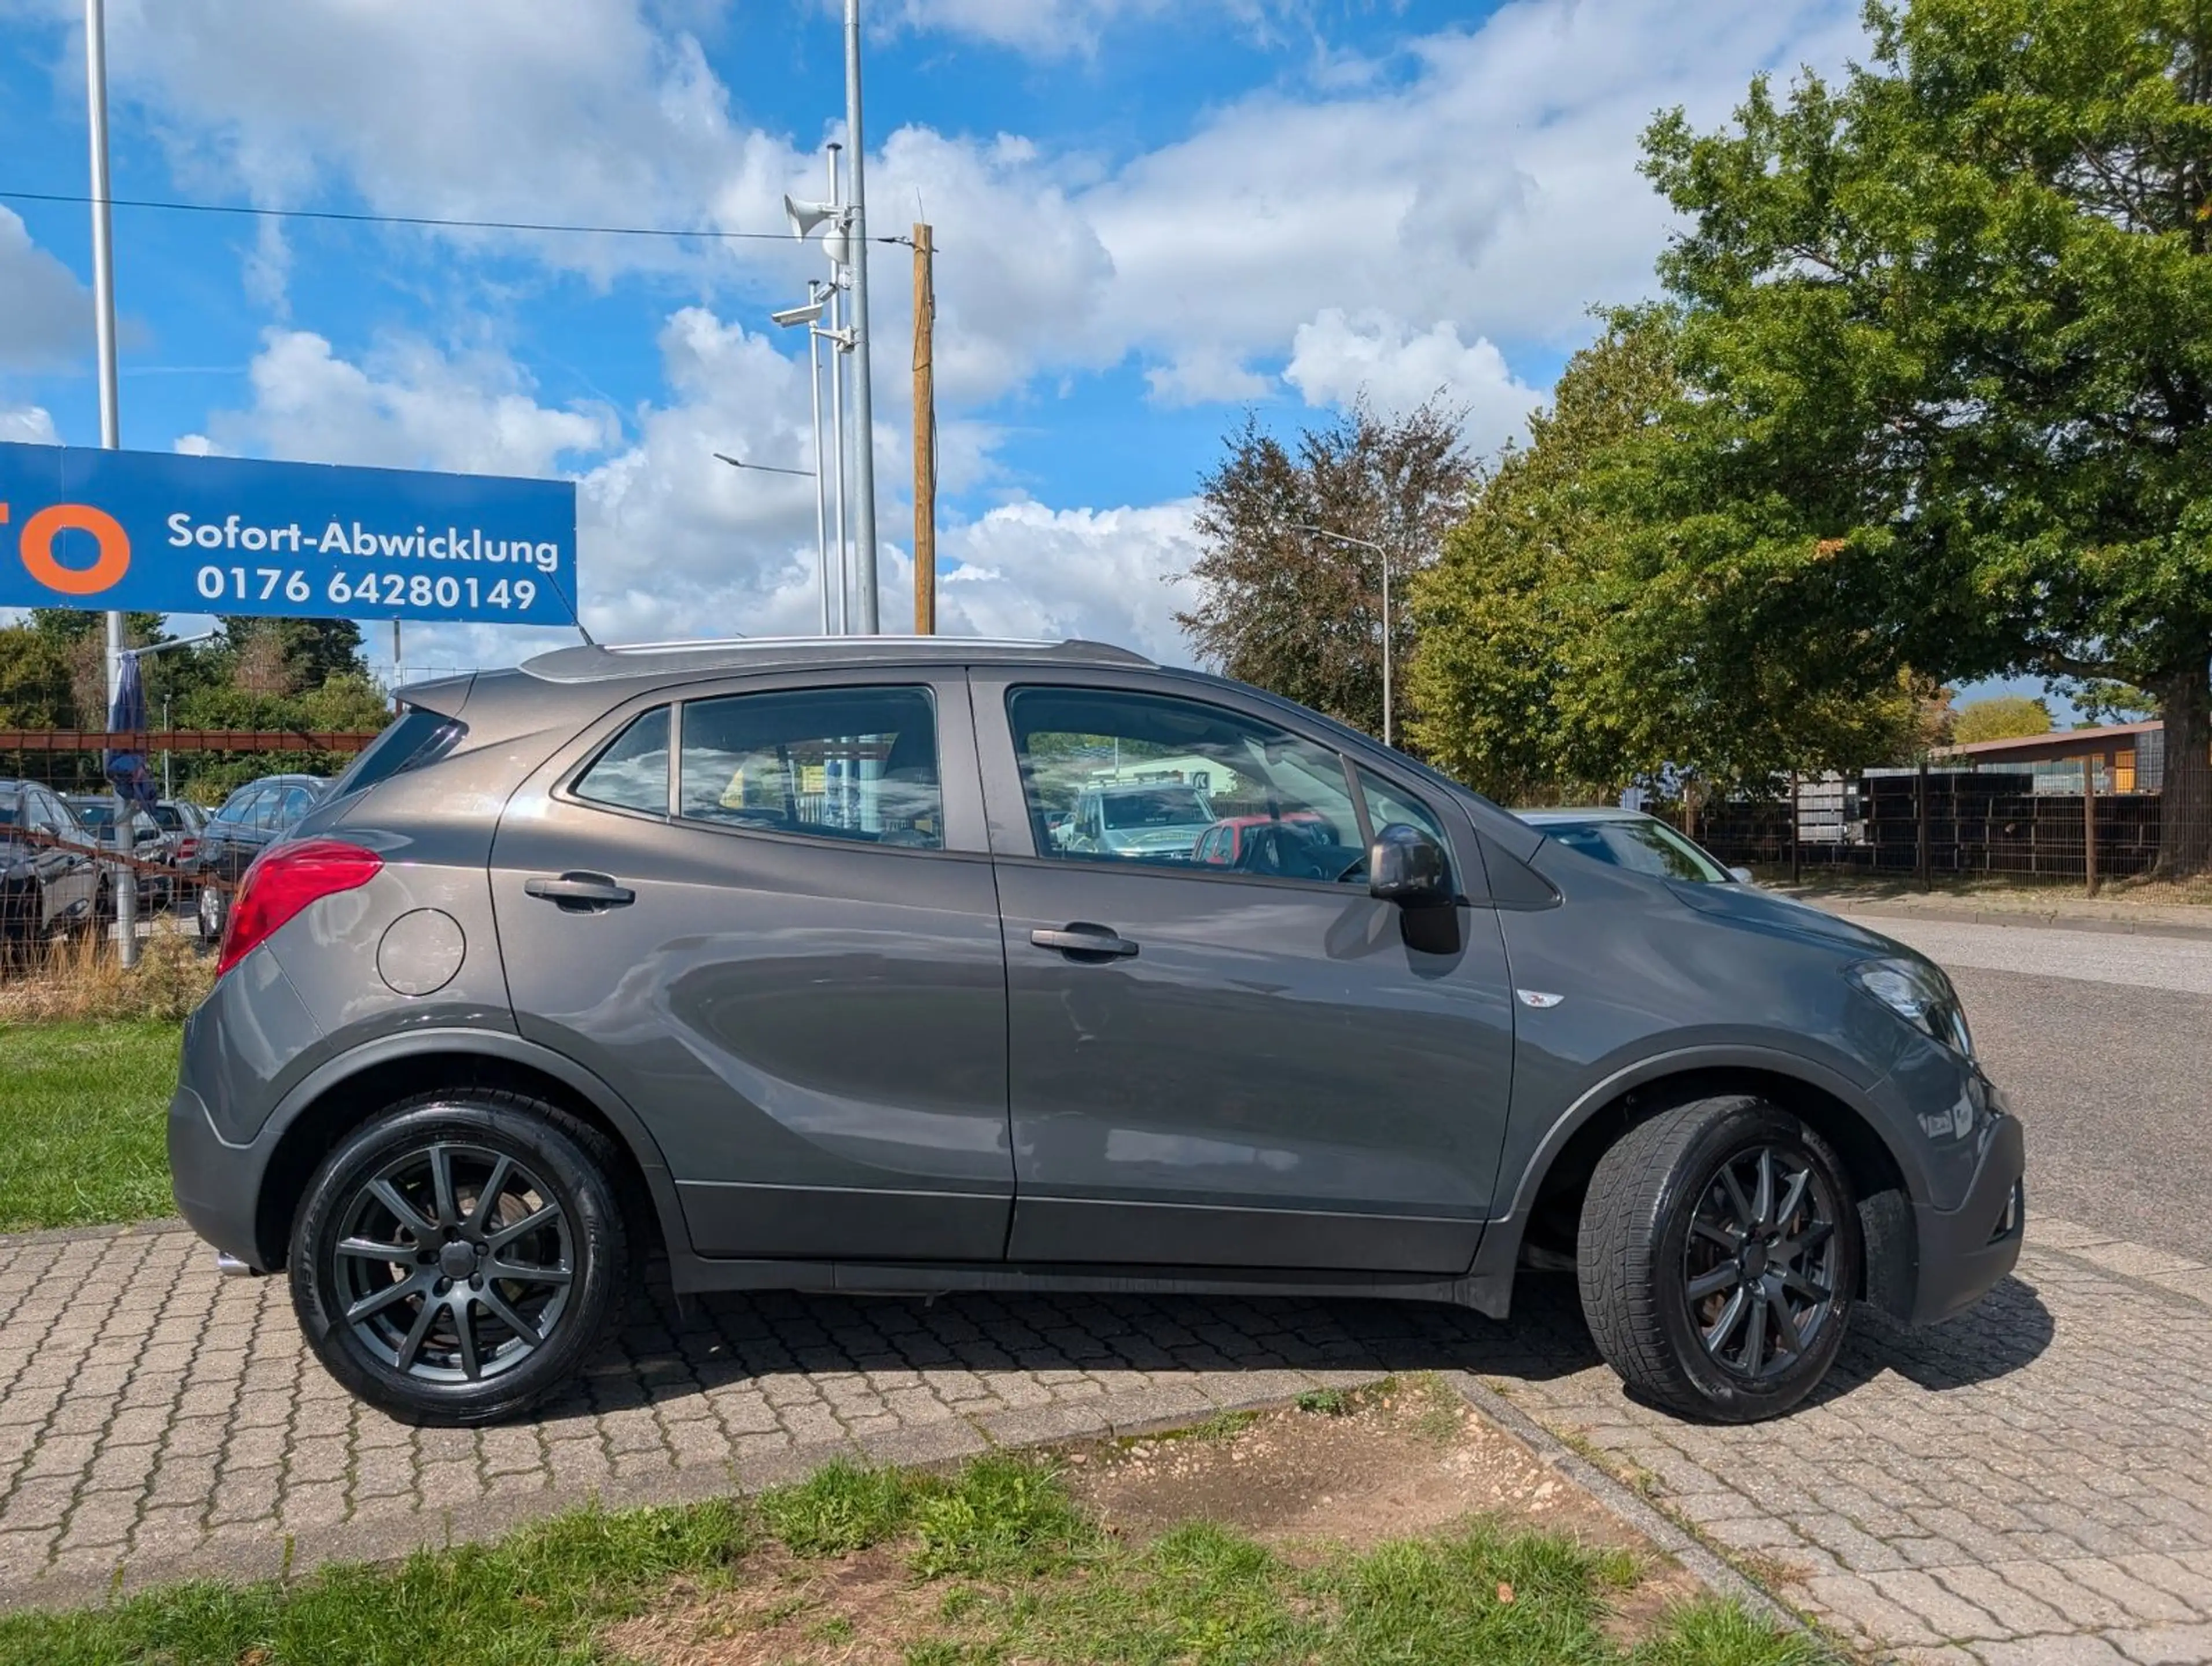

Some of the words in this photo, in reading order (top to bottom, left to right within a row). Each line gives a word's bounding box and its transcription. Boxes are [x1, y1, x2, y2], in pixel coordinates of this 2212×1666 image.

[0, 503, 131, 595] O
[167, 512, 558, 572] Sofort-Abwicklung
[197, 566, 311, 602] 0176
[327, 572, 536, 609] 64280149
